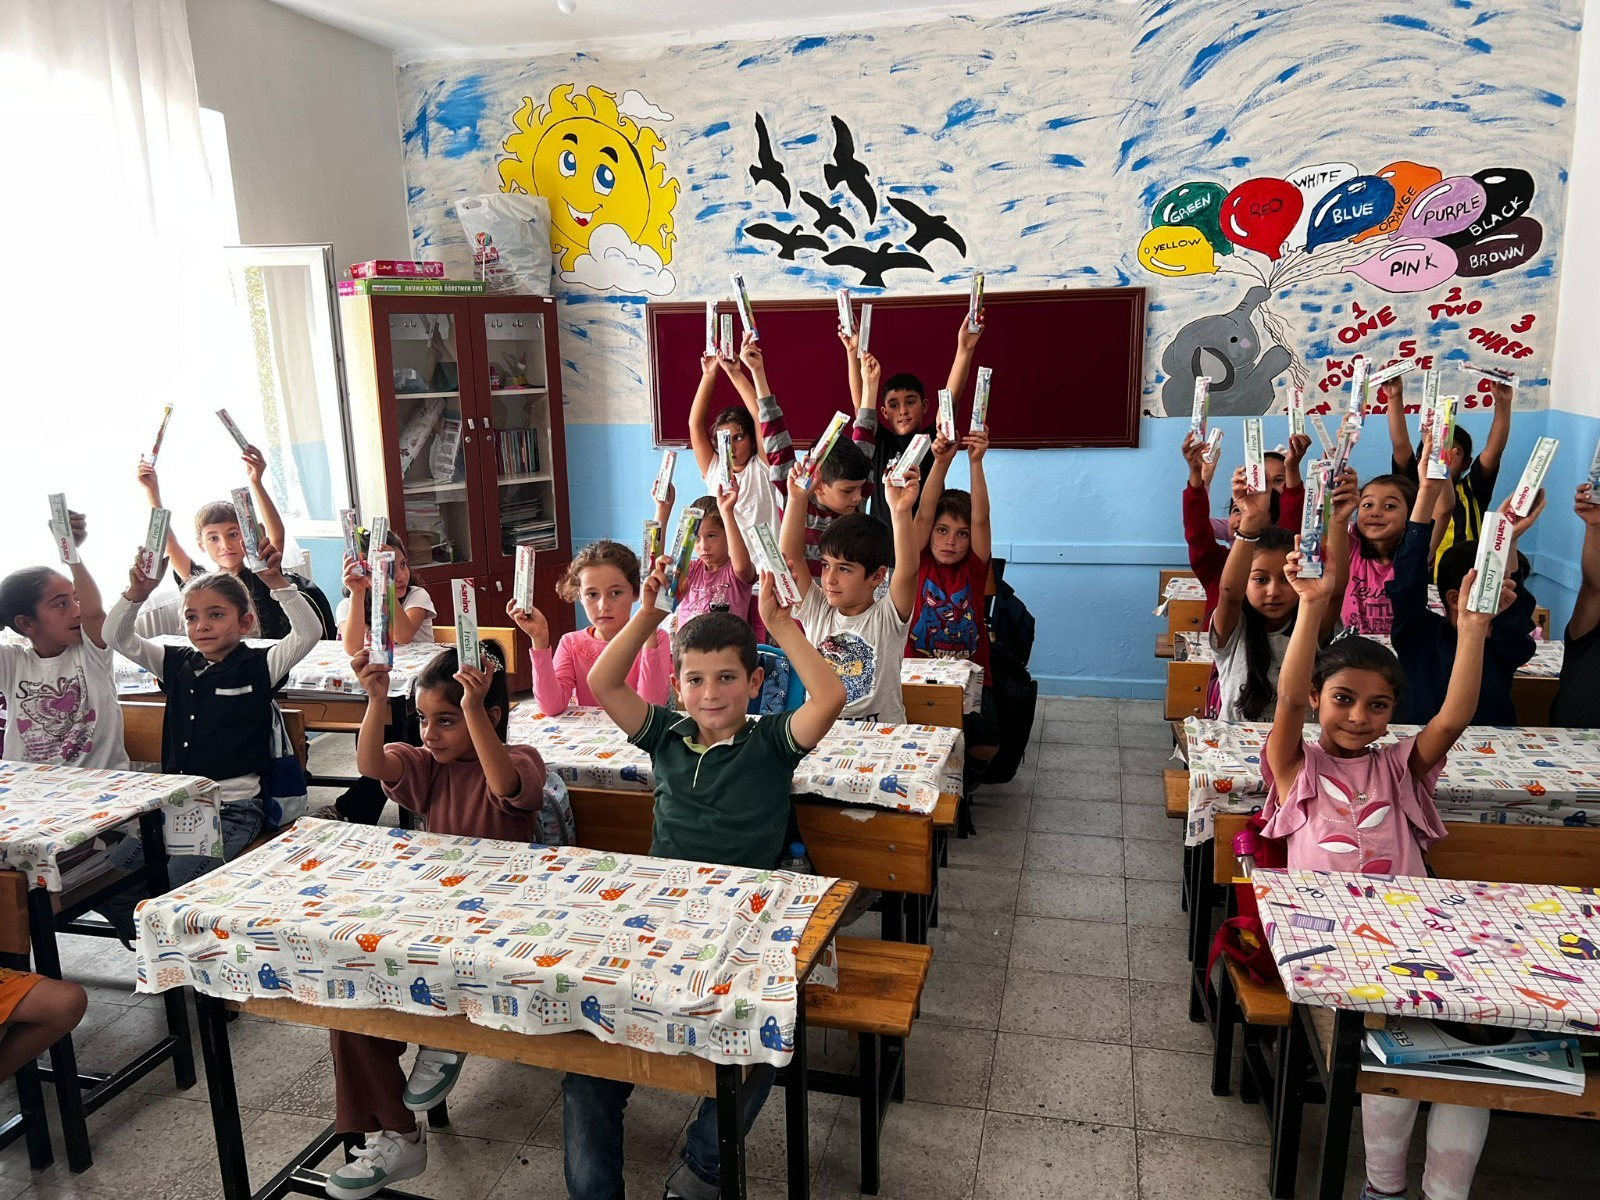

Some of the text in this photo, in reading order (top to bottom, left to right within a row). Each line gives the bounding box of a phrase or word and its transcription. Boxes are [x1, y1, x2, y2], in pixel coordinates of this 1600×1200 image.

[1293, 168, 1341, 188] WHITE
[1169, 192, 1212, 224] GREEN
[1332, 202, 1374, 224] BLUE
[1379, 186, 1417, 232] ORANGE
[1423, 192, 1480, 226] PURPLE
[1468, 196, 1524, 236] BLACK
[1153, 238, 1201, 254] YELLOW
[1469, 244, 1525, 269] BROWN
[1427, 300, 1482, 320] TWO
[1338, 305, 1398, 344] ONE
[1511, 314, 1536, 333] 3
[1533, 455, 1545, 473] Fresh
[1251, 464, 1259, 488] sanino
[1304, 487, 1314, 529] EXPERDENT
[1516, 485, 1530, 511] sanino
[55, 508, 64, 525] Fresh
[152, 523, 160, 539] Fresh
[1494, 518, 1506, 551] sanino
[60, 537, 70, 560] sanino
[766, 540, 778, 559] Fresh
[145, 551, 154, 575] sanino
[781, 573, 795, 599] sanino
[1484, 569, 1496, 592] Fresh
[460, 583, 471, 614] sanino
[1358, 602, 1394, 617] LITTL
[463, 630, 471, 652] Fresh
